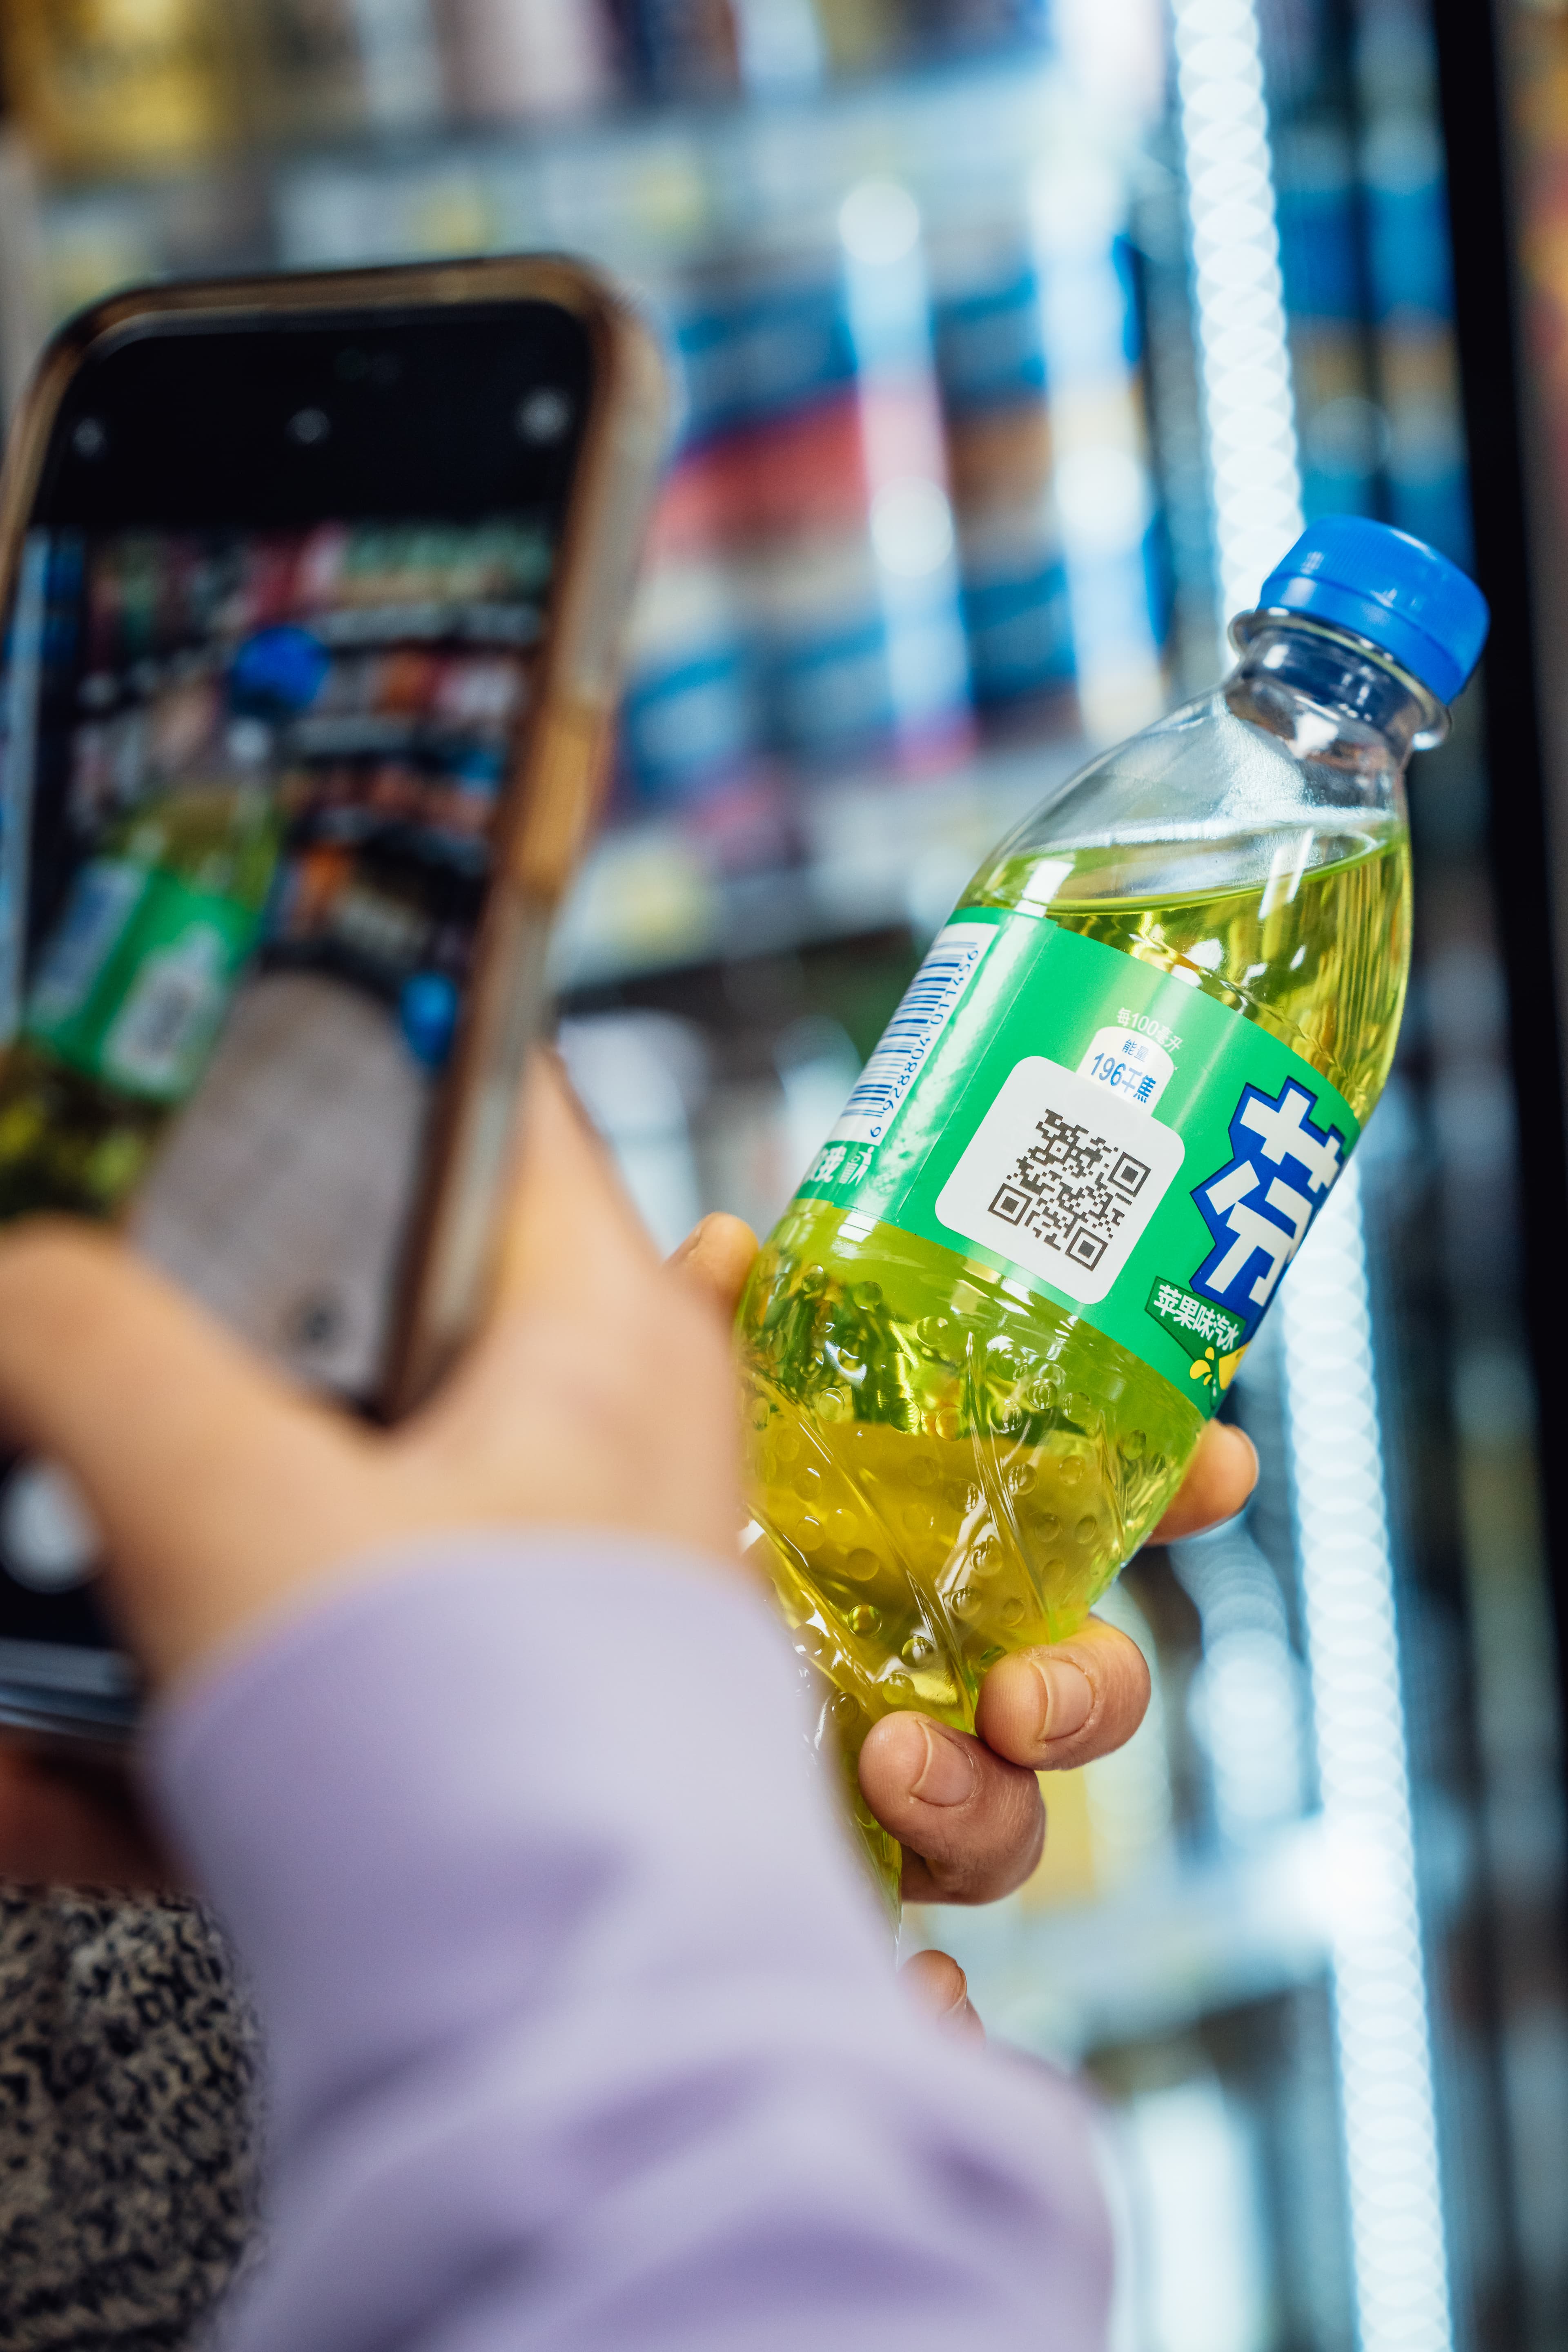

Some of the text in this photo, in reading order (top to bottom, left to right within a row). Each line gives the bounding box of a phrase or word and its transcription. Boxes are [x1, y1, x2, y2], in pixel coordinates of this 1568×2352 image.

[1117, 1007, 1183, 1051] 每100毫升
[1123, 1039, 1150, 1062] 能量
[1091, 1052, 1157, 1104] 196千焦
[1154, 1284, 1239, 1350] 苹果味汽水
